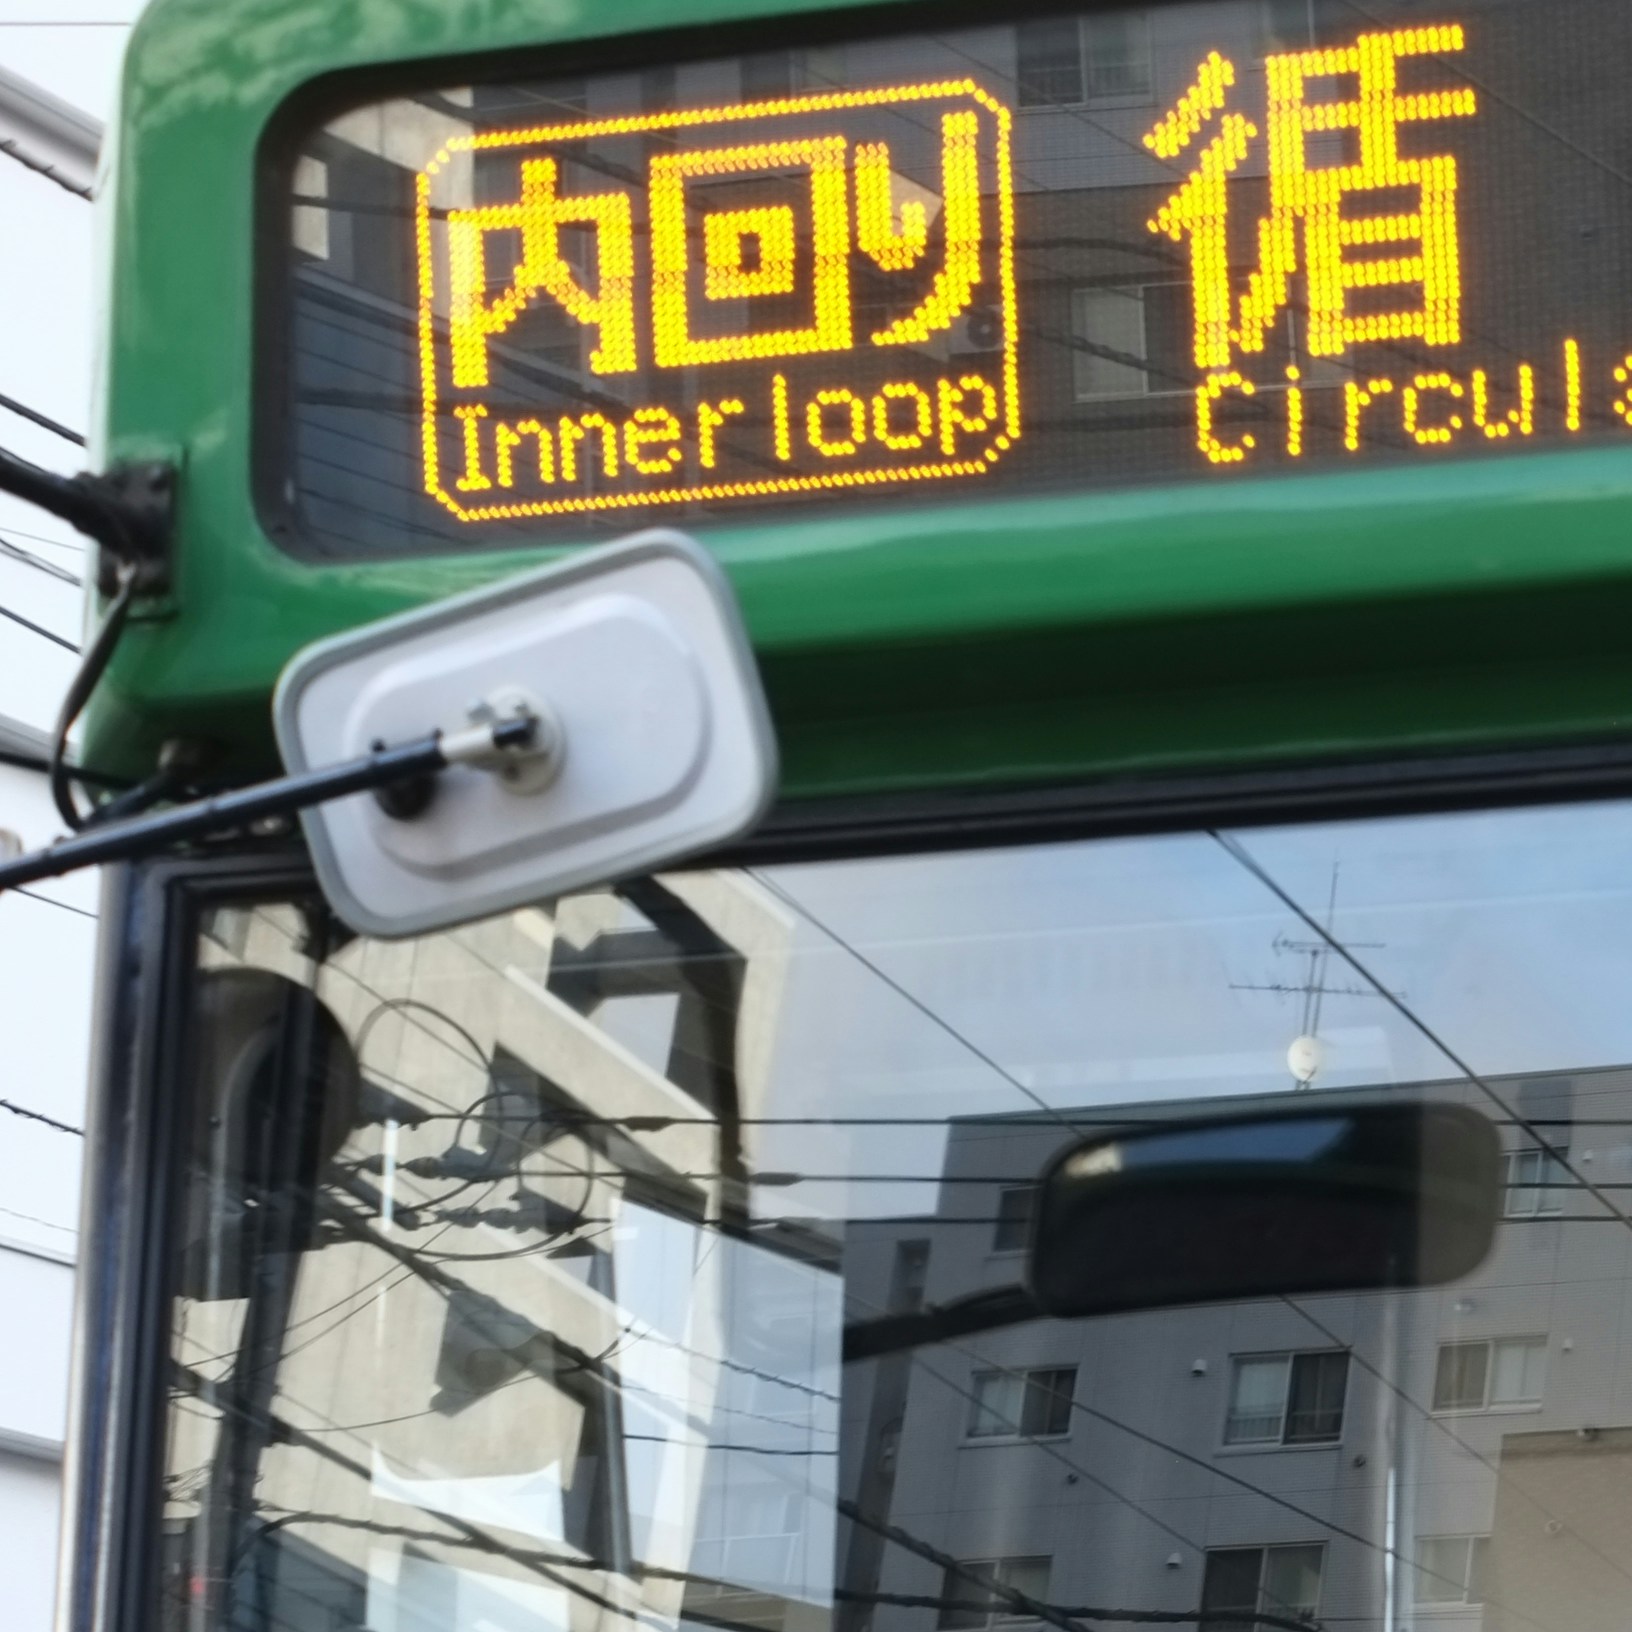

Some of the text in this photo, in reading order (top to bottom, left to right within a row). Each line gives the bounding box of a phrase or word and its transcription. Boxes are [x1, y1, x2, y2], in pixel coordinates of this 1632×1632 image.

[449, 110, 983, 388] 内回り
[455, 373, 998, 492] Inner loop
